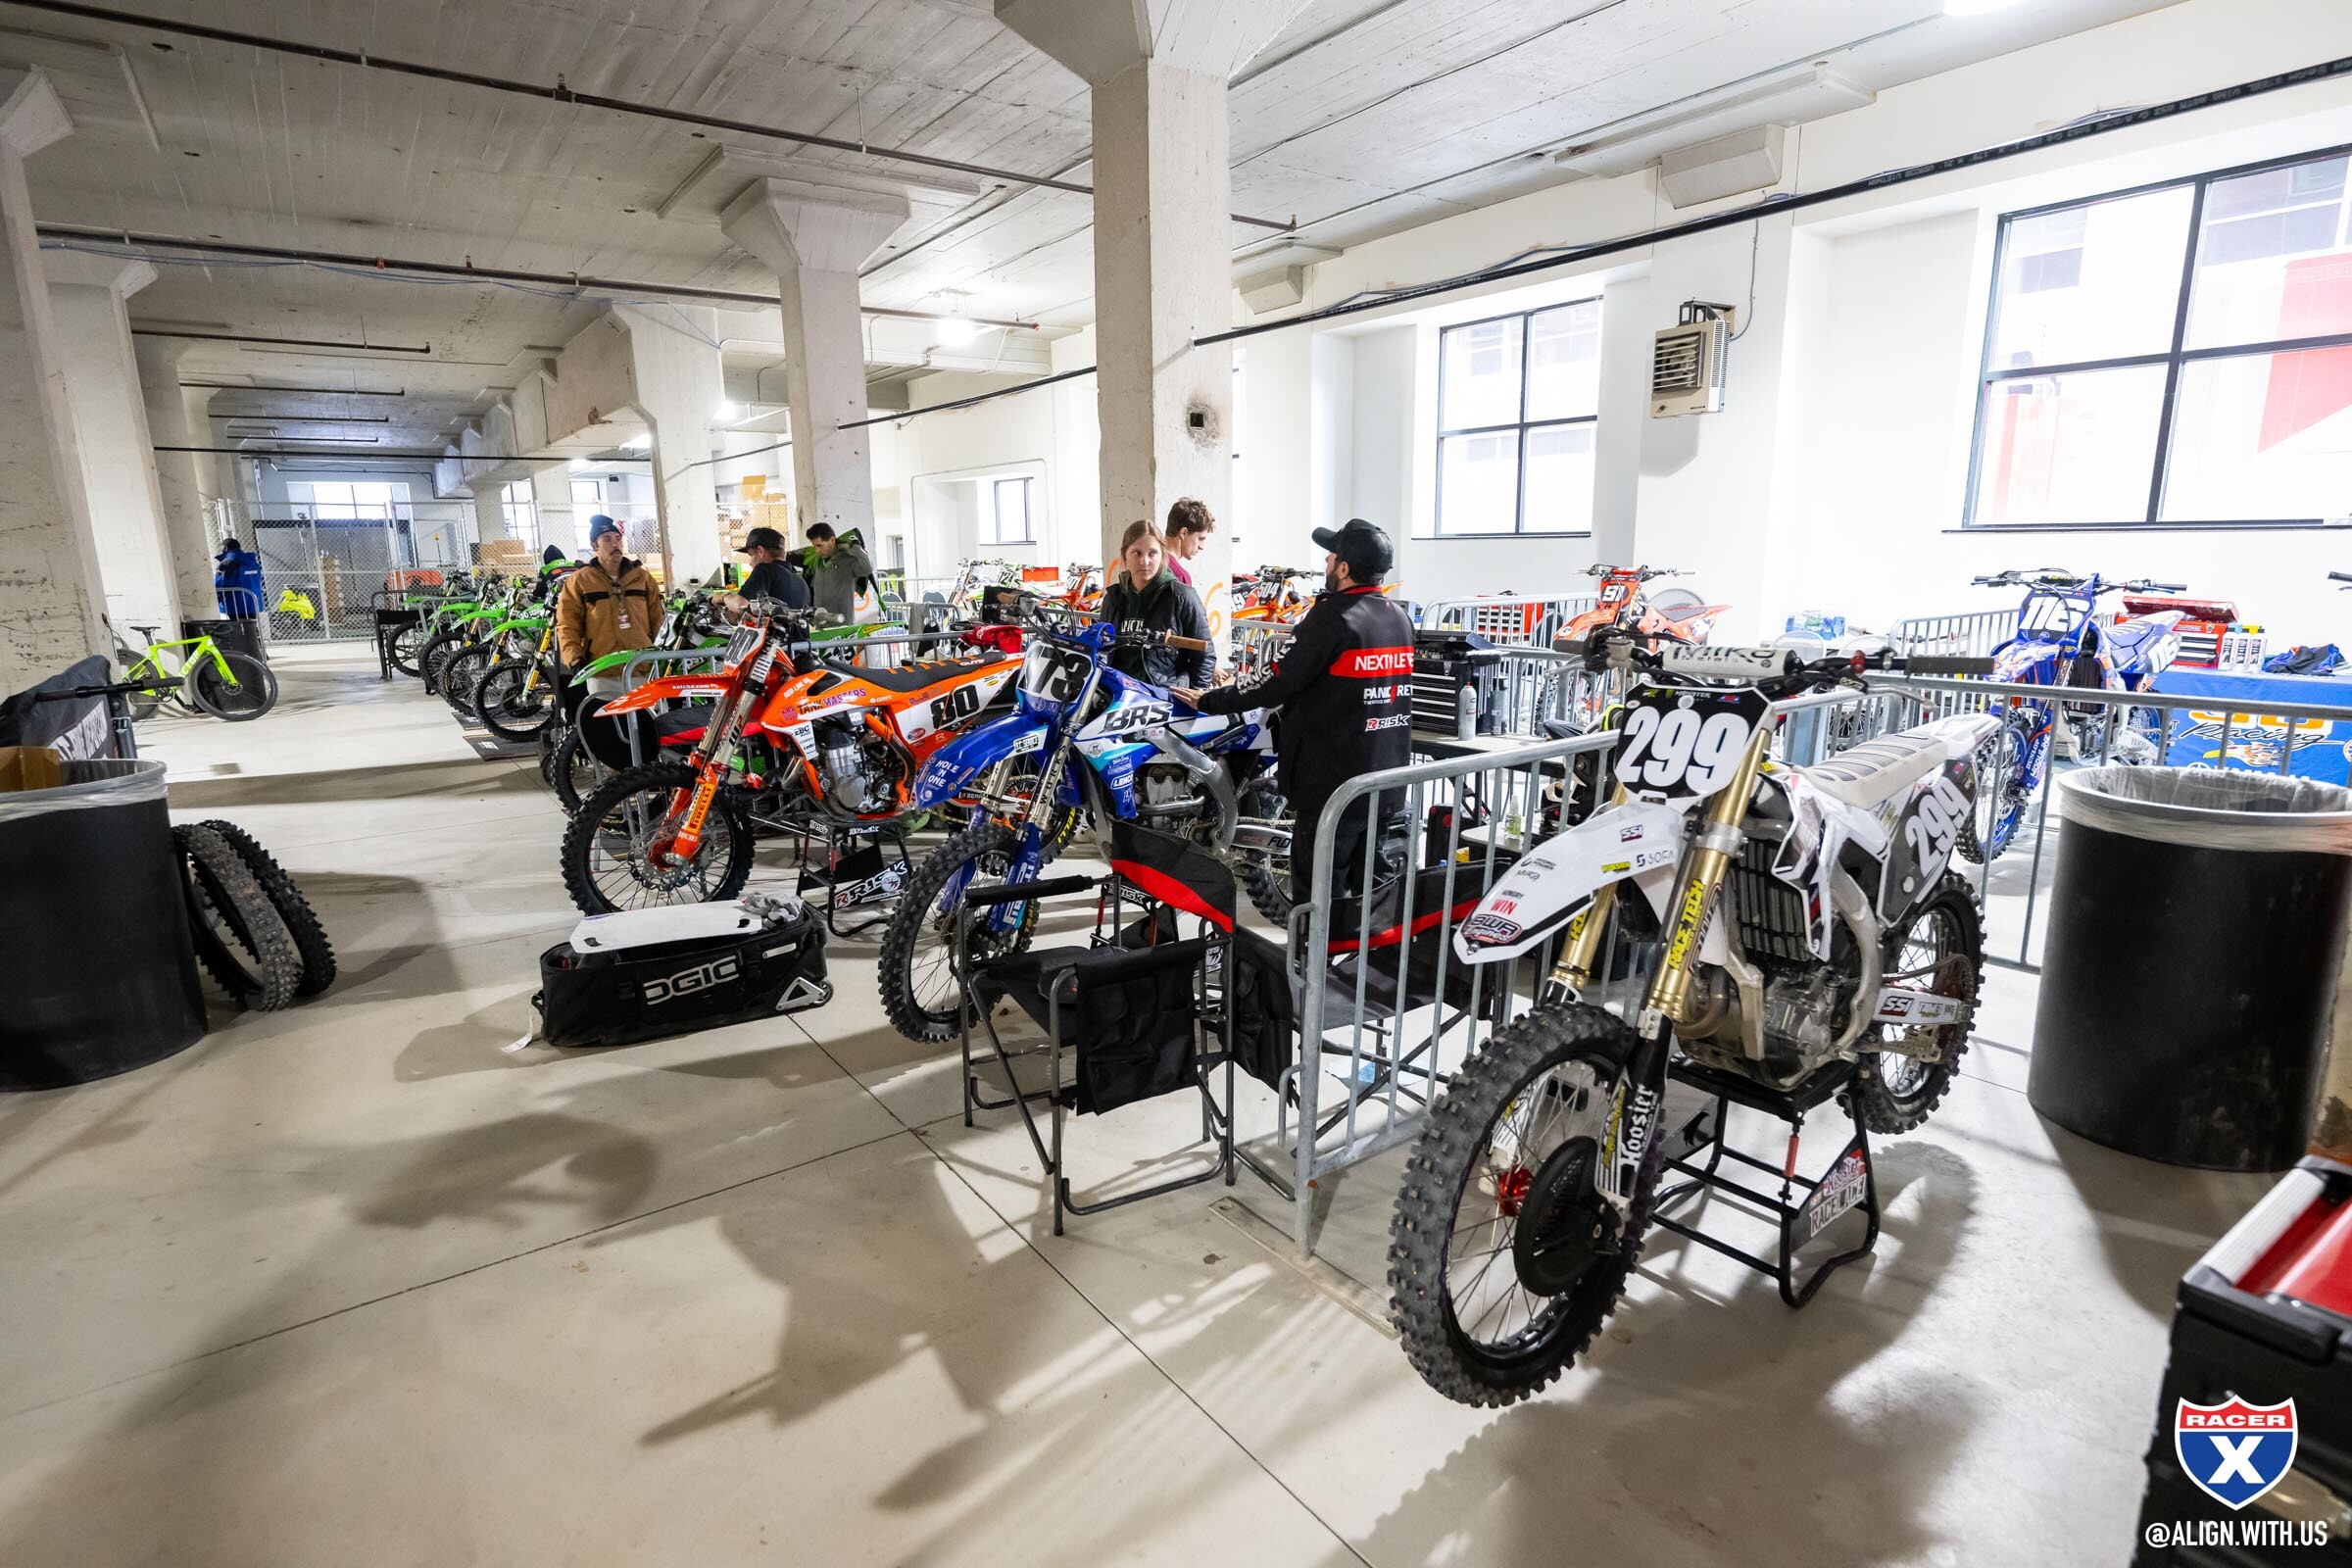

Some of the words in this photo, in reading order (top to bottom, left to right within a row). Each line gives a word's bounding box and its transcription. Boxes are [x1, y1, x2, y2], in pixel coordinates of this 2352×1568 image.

[1602, 585, 1627, 603] 91
[2019, 596, 2090, 632] 116
[725, 626, 760, 666] 80
[1354, 654, 1390, 671] NEXT
[930, 684, 980, 730] 80
[1617, 706, 1750, 795] 299
[935, 760, 960, 774] HOLE
[1039, 744, 1066, 805] WORKS
[927, 775, 947, 788] ONE
[1620, 824, 1643, 840] SSI
[1267, 836, 1293, 849] FLO
[1491, 899, 1518, 915] WIN
[1668, 925, 1693, 970] RACE
[1880, 996, 1914, 1013] SSI
[1617, 1082, 1654, 1174] Hoosier
